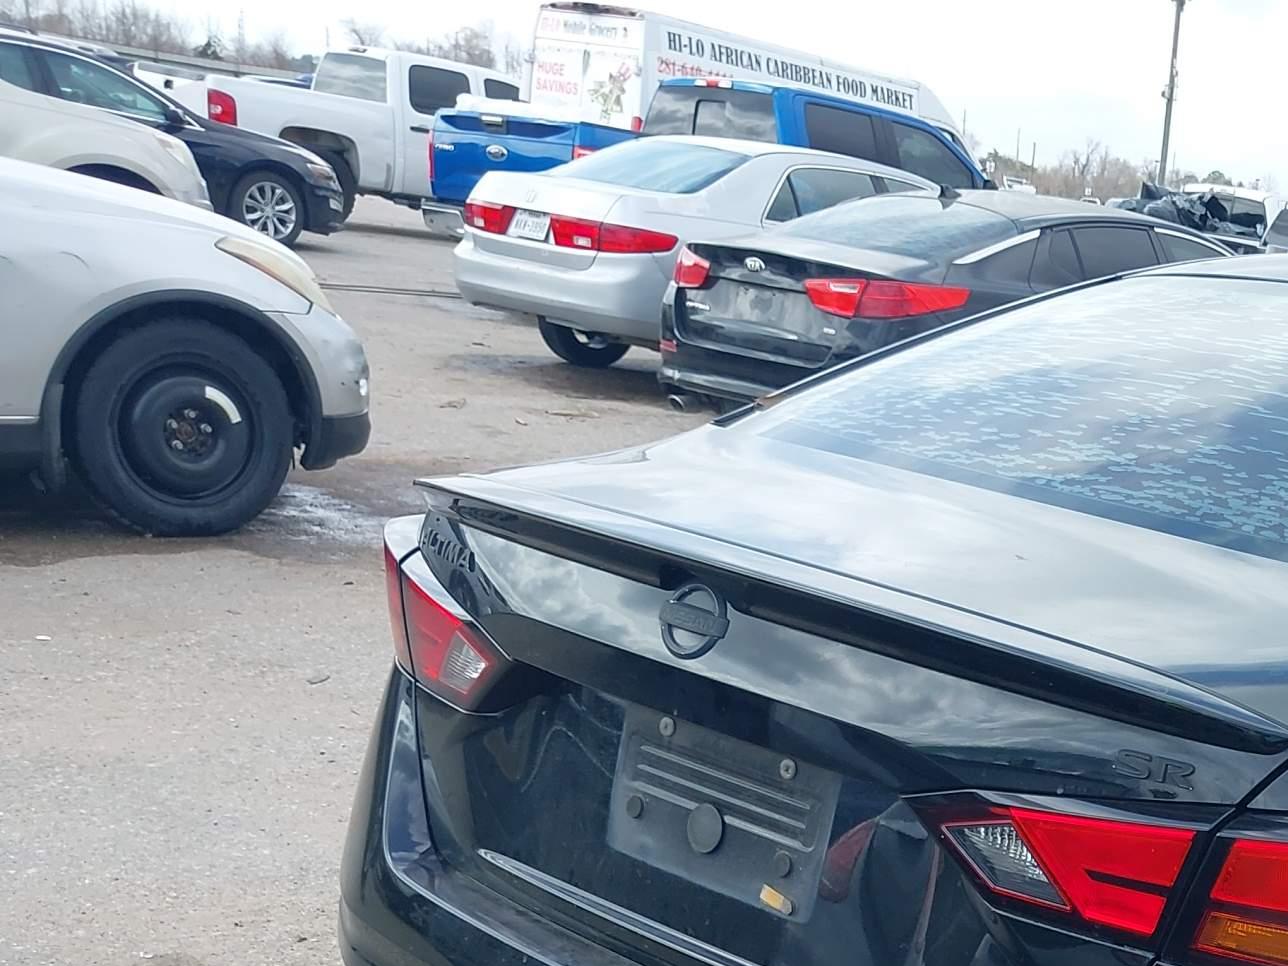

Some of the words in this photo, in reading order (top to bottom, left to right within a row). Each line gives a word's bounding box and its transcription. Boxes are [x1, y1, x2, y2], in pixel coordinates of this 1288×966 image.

[536, 78, 579, 96] SAVINGS
[537, 61, 566, 77] HUGE
[667, 31, 705, 58] HI-LO
[710, 42, 762, 73] AFRICAN
[766, 57, 833, 90] CARIBBEAN
[836, 74, 867, 98] FOOD
[870, 83, 914, 111] MARKET
[422, 527, 476, 573] ALTIMA
[1113, 749, 1195, 791] SR
